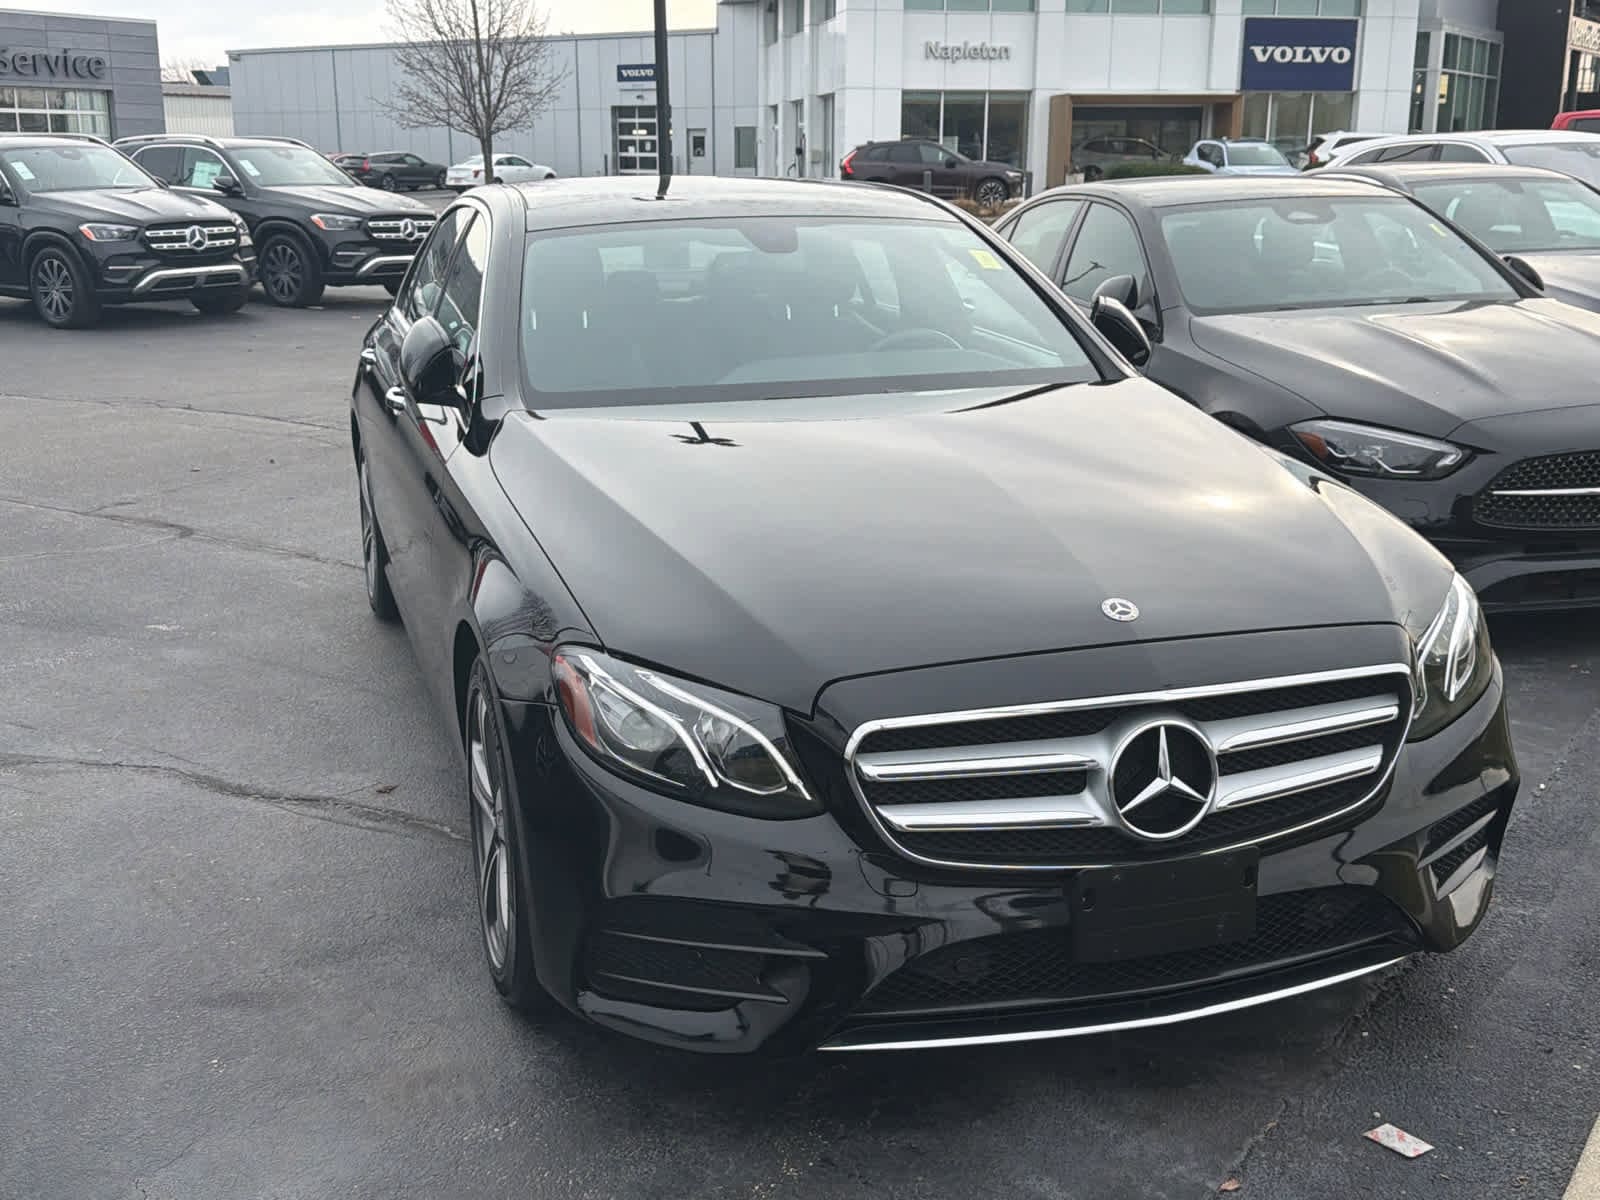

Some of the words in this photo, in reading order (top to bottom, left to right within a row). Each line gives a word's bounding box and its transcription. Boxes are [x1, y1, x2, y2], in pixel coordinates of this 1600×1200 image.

[925, 40, 1010, 64] Napleton
[1249, 45, 1352, 64] VOLVO
[621, 69, 655, 77] VOLVO
